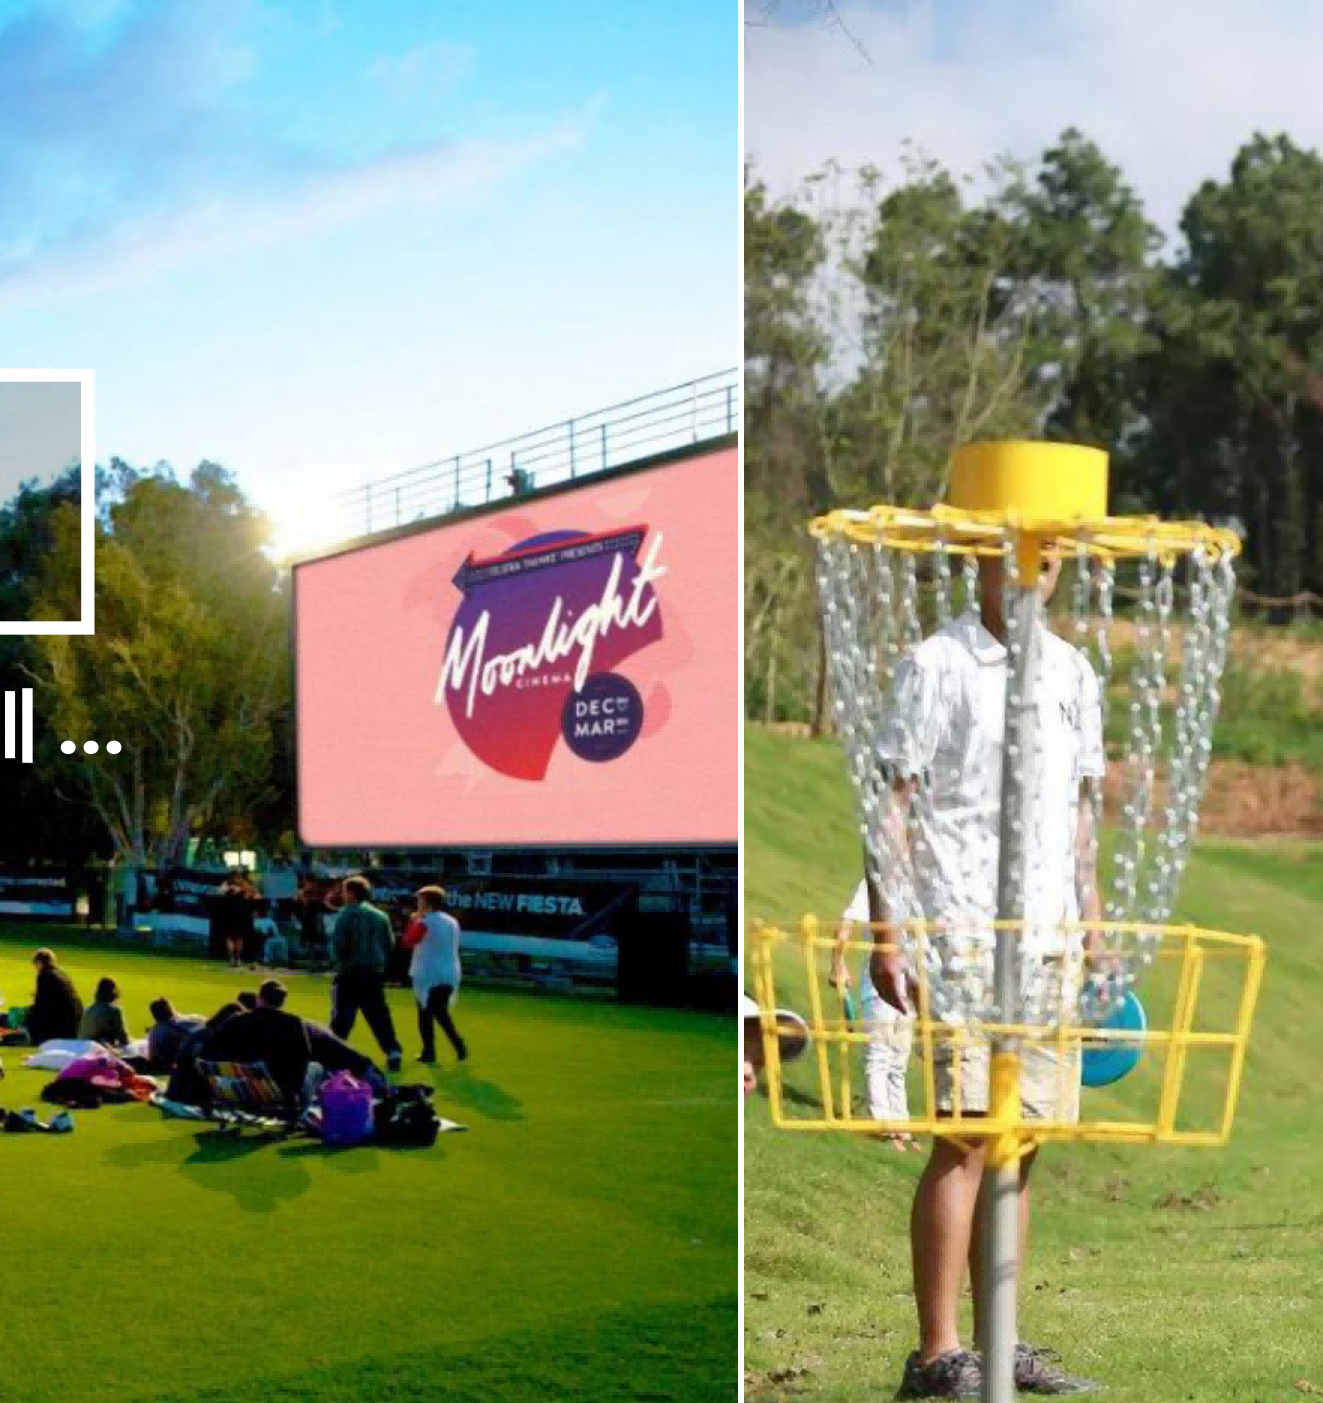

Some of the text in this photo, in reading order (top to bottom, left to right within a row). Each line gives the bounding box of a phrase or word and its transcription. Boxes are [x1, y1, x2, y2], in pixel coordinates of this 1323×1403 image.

[434, 532, 668, 719] Moonlight
[515, 673, 571, 690] CINEMA
[576, 697, 615, 718] DEC
[574, 718, 615, 738] MAR
[475, 892, 516, 912] NEW
[517, 894, 584, 916] FIESTA
